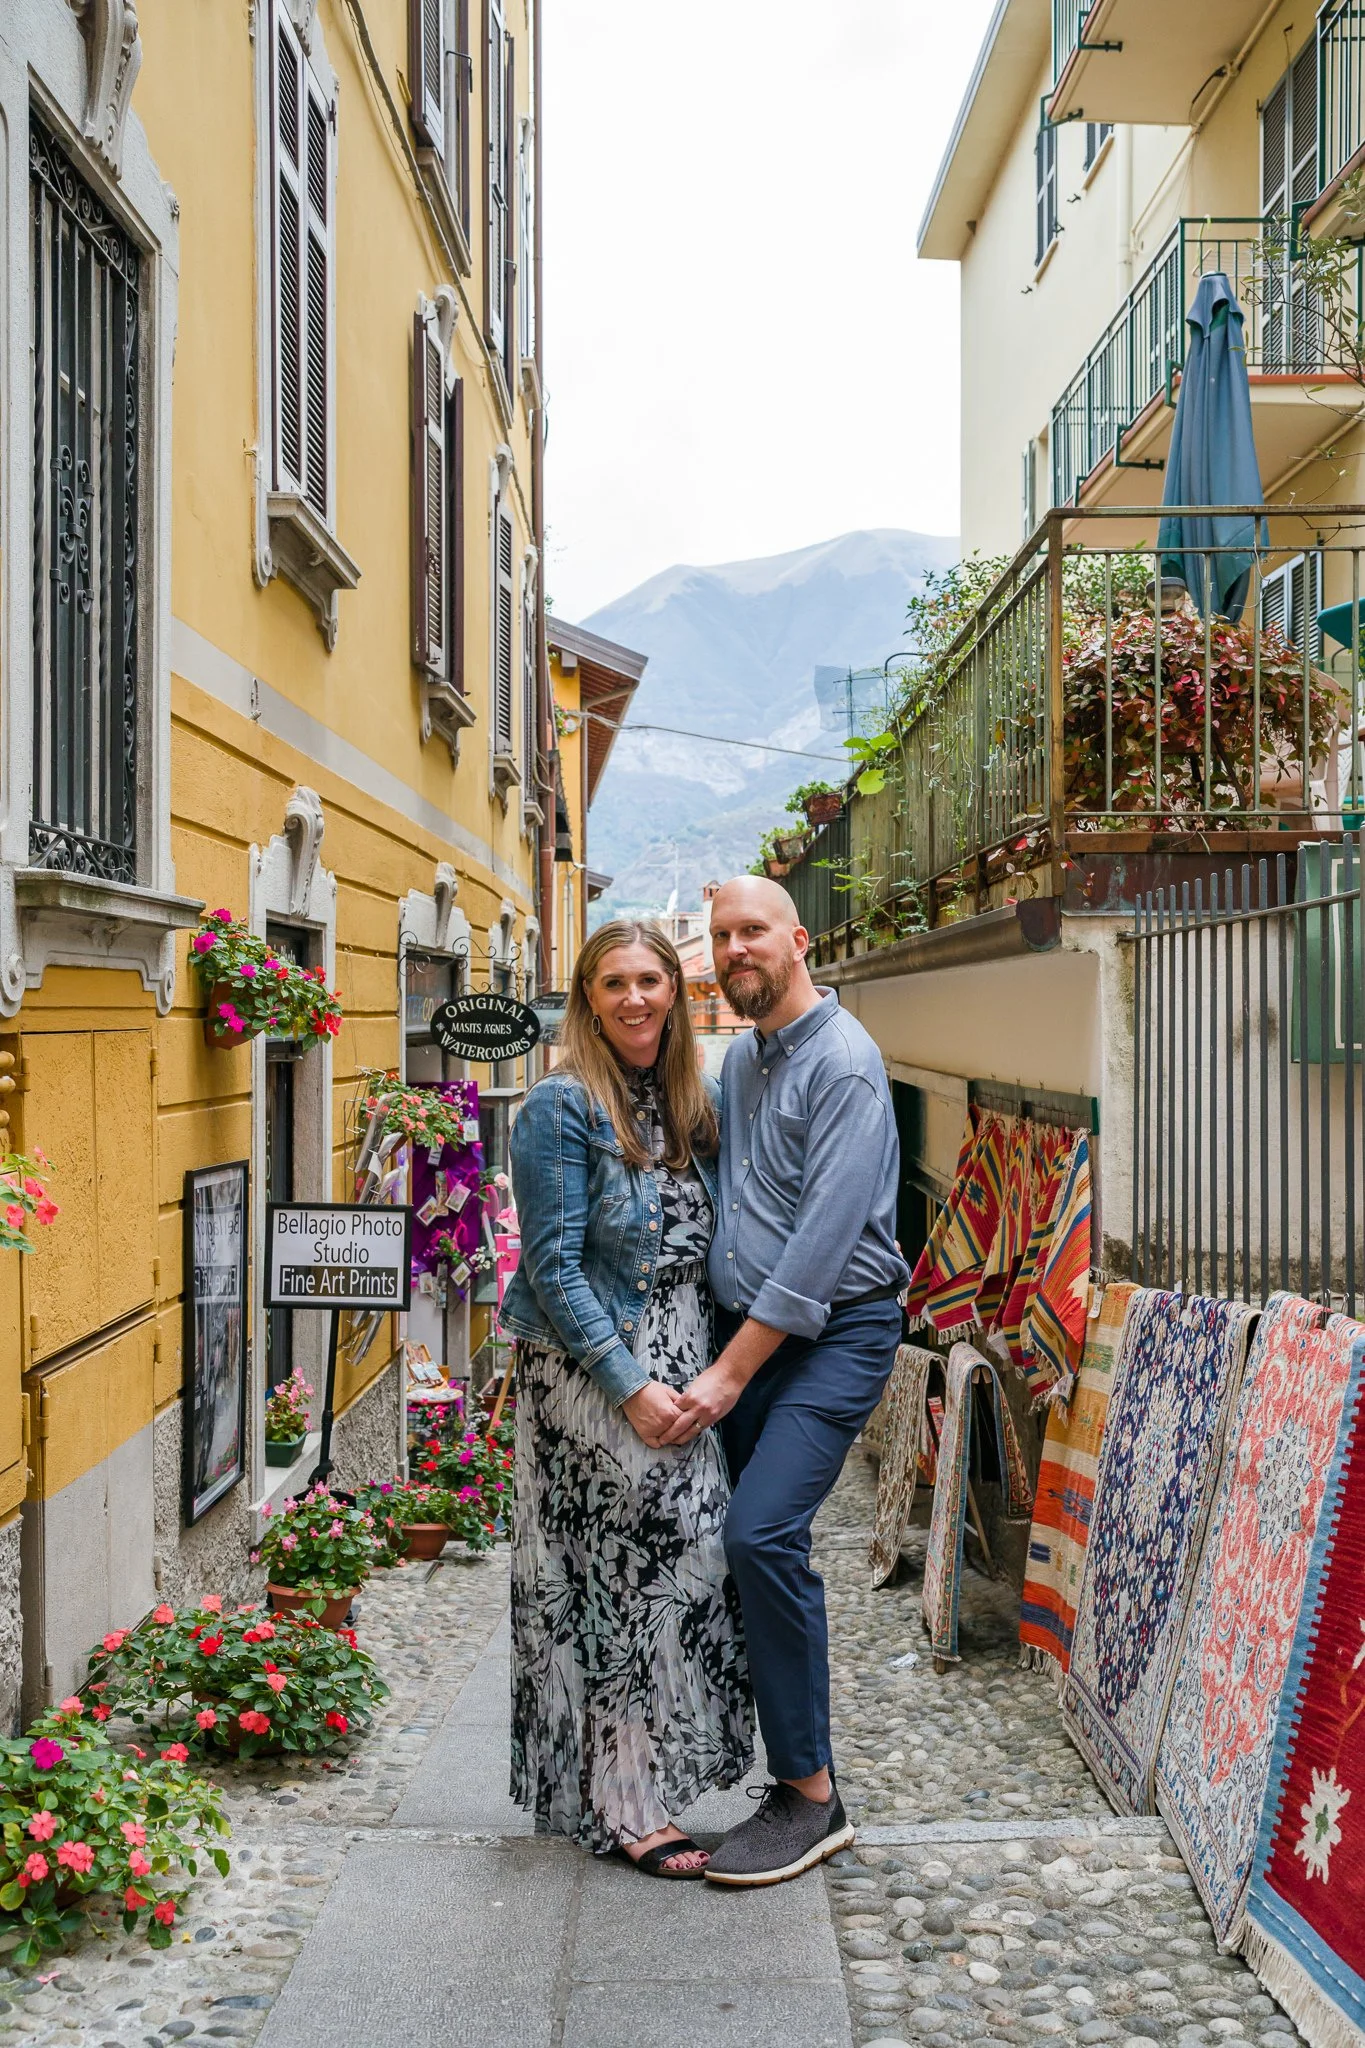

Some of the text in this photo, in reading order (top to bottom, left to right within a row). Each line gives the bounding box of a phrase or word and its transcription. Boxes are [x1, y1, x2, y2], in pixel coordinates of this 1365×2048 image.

[445, 997, 525, 1023] ORIGINAL
[451, 1022, 482, 1034] MASITS
[440, 1031, 531, 1060] WATERCOLORS
[278, 1212, 403, 1240] Bellagio Photo
[313, 1241, 370, 1264] Studio
[281, 1267, 395, 1295] Fine Art Prints
